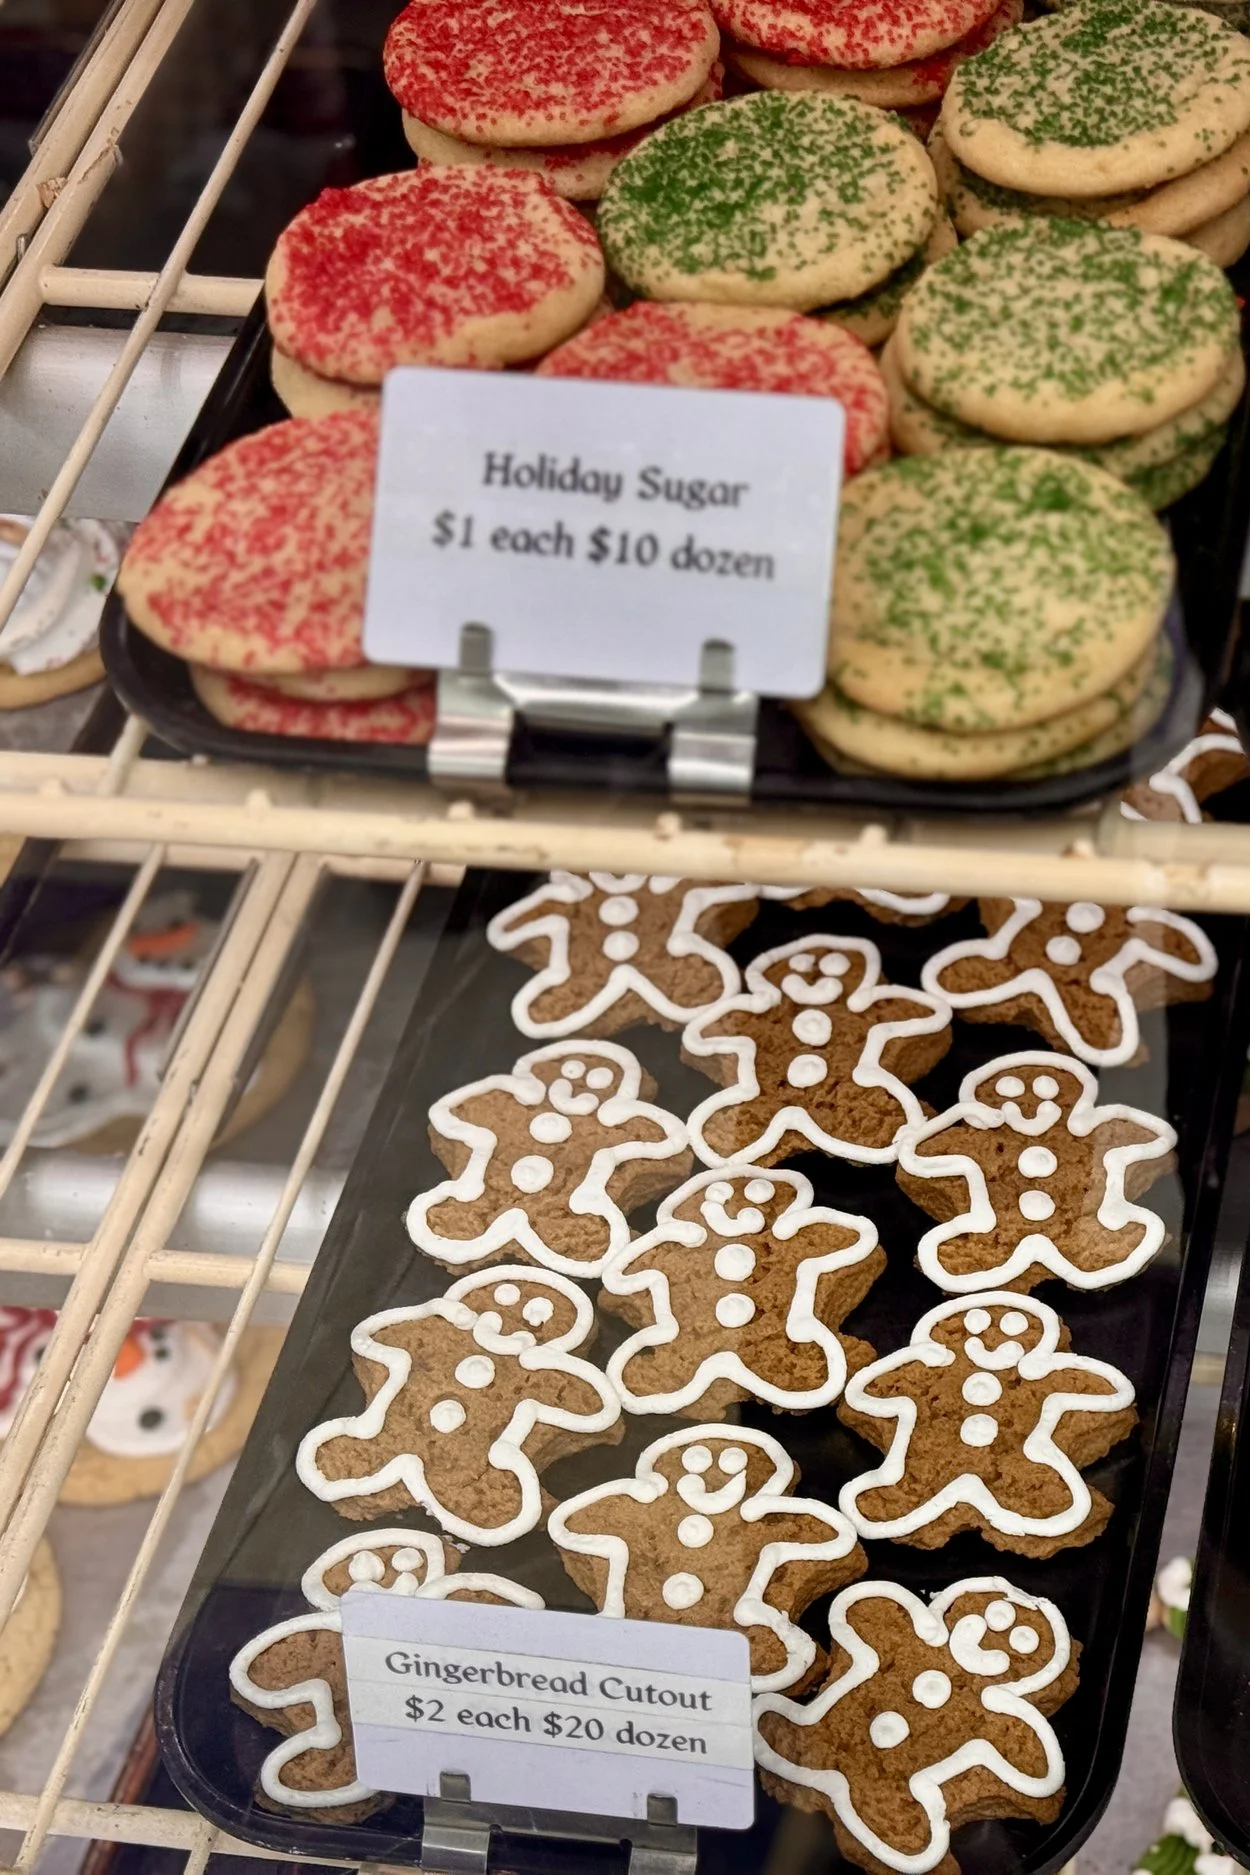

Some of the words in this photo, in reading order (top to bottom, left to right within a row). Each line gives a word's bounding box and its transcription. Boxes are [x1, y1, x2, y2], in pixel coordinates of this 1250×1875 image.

[482, 452, 622, 502] Holiday
[637, 466, 750, 510] Sugar
[432, 511, 474, 548] $1
[490, 521, 574, 558] each
[588, 526, 659, 566] $10
[671, 535, 775, 580] dozen
[385, 1651, 588, 1696] Gingerbread
[599, 1677, 713, 1711] Cutout
[405, 1695, 446, 1723] $2
[457, 1706, 531, 1733] each
[543, 1711, 604, 1741] $20
[616, 1721, 707, 1754] dozen
